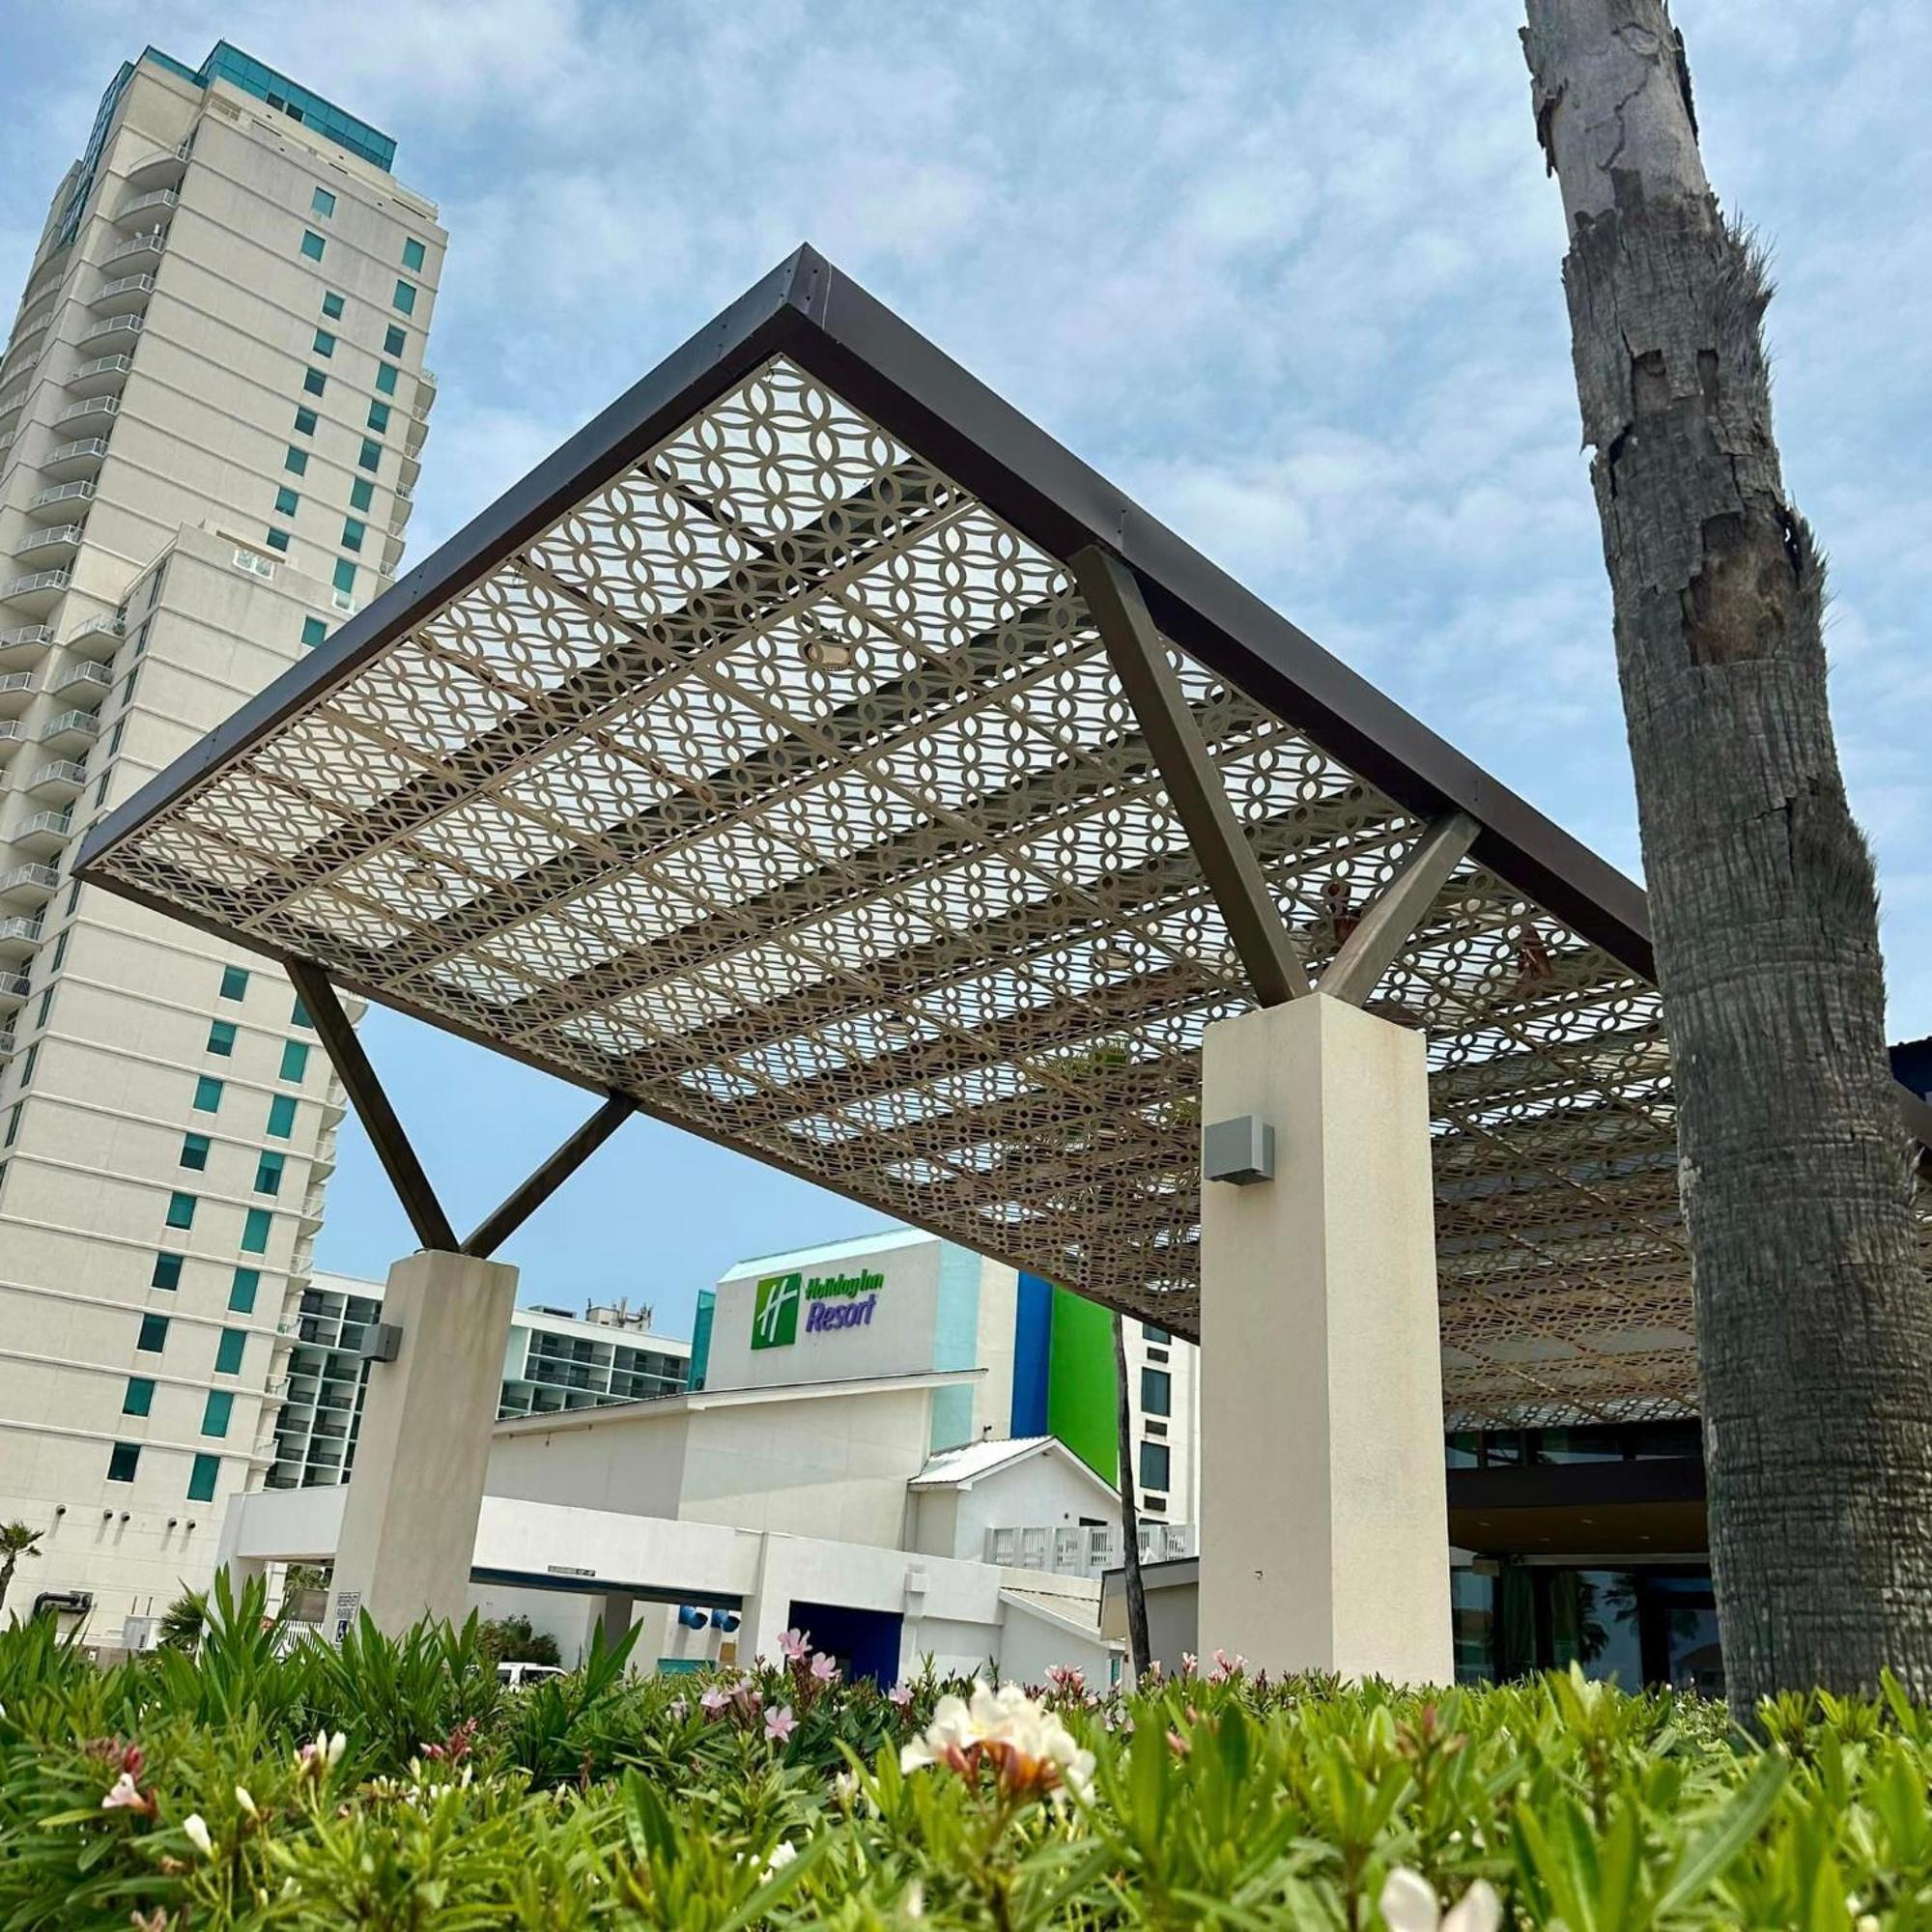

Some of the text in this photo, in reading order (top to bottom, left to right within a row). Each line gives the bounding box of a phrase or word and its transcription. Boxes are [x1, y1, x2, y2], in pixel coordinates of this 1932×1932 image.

[806, 1268, 885, 1300] Holiday Inn
[806, 1293, 876, 1332] Resort
